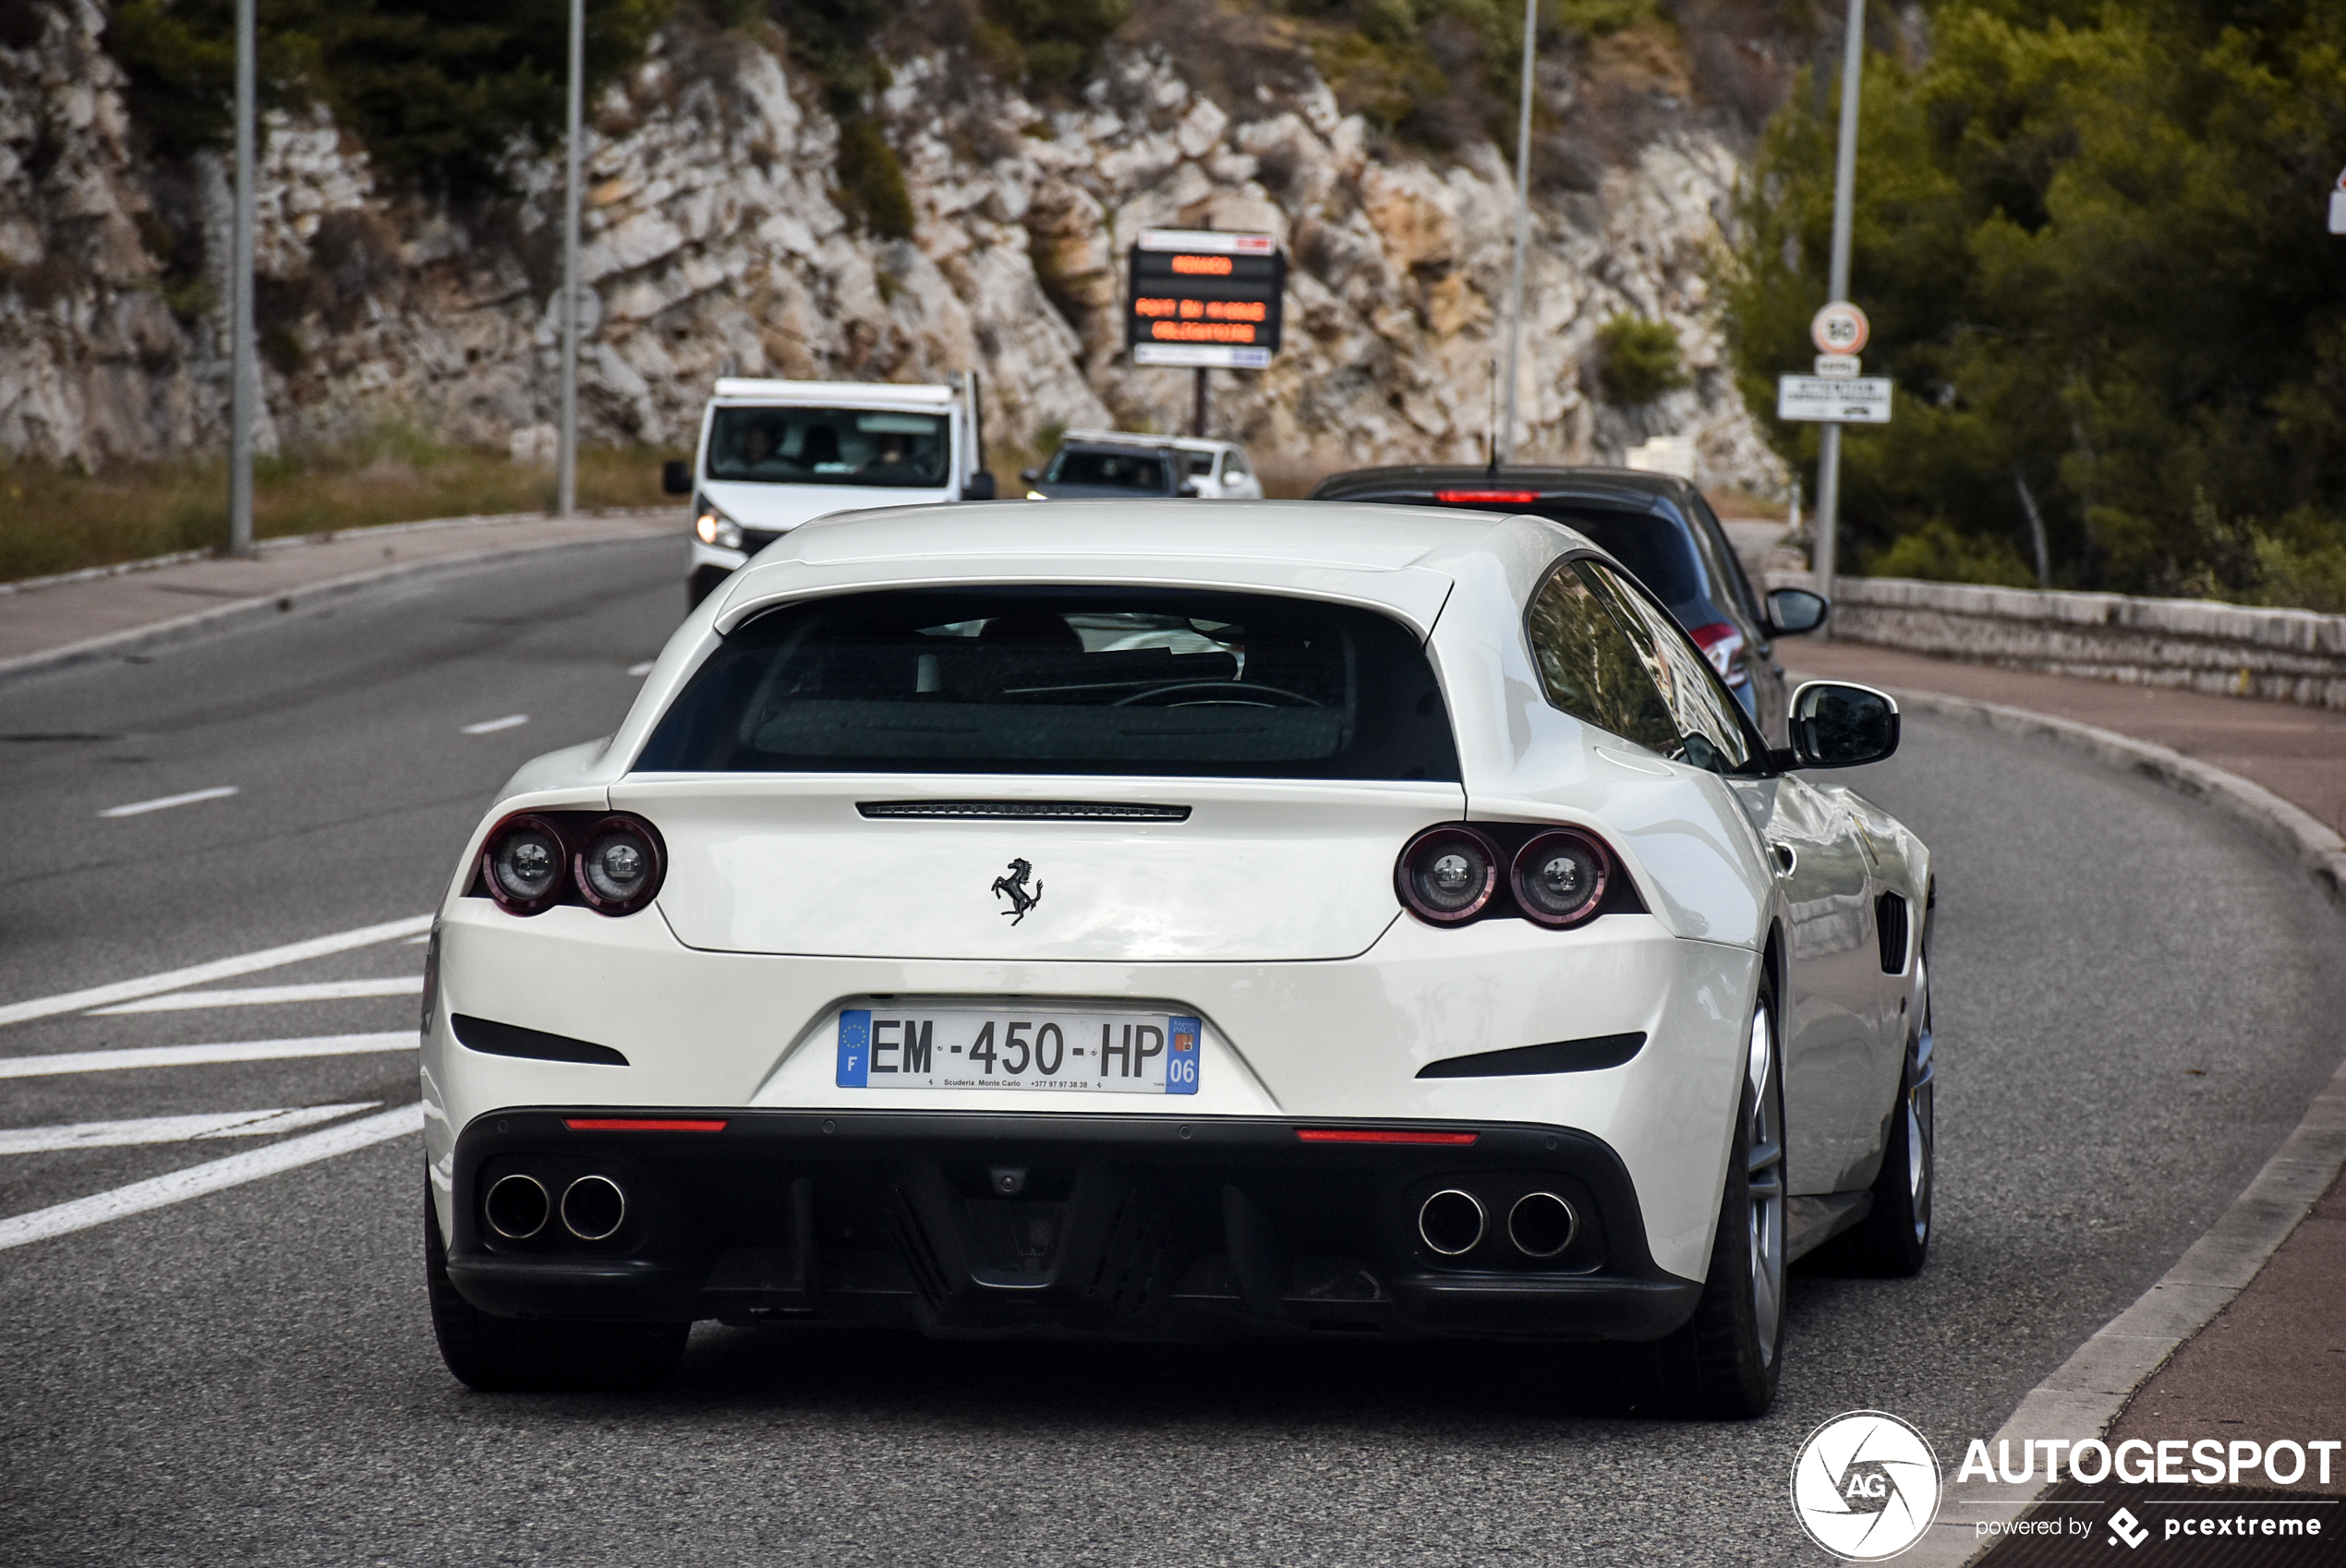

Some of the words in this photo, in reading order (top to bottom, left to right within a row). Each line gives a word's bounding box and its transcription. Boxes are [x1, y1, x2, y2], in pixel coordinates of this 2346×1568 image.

[848, 1056, 858, 1071] F
[1170, 1059, 1194, 1083] 06
[978, 1079, 1000, 1087] Monte
